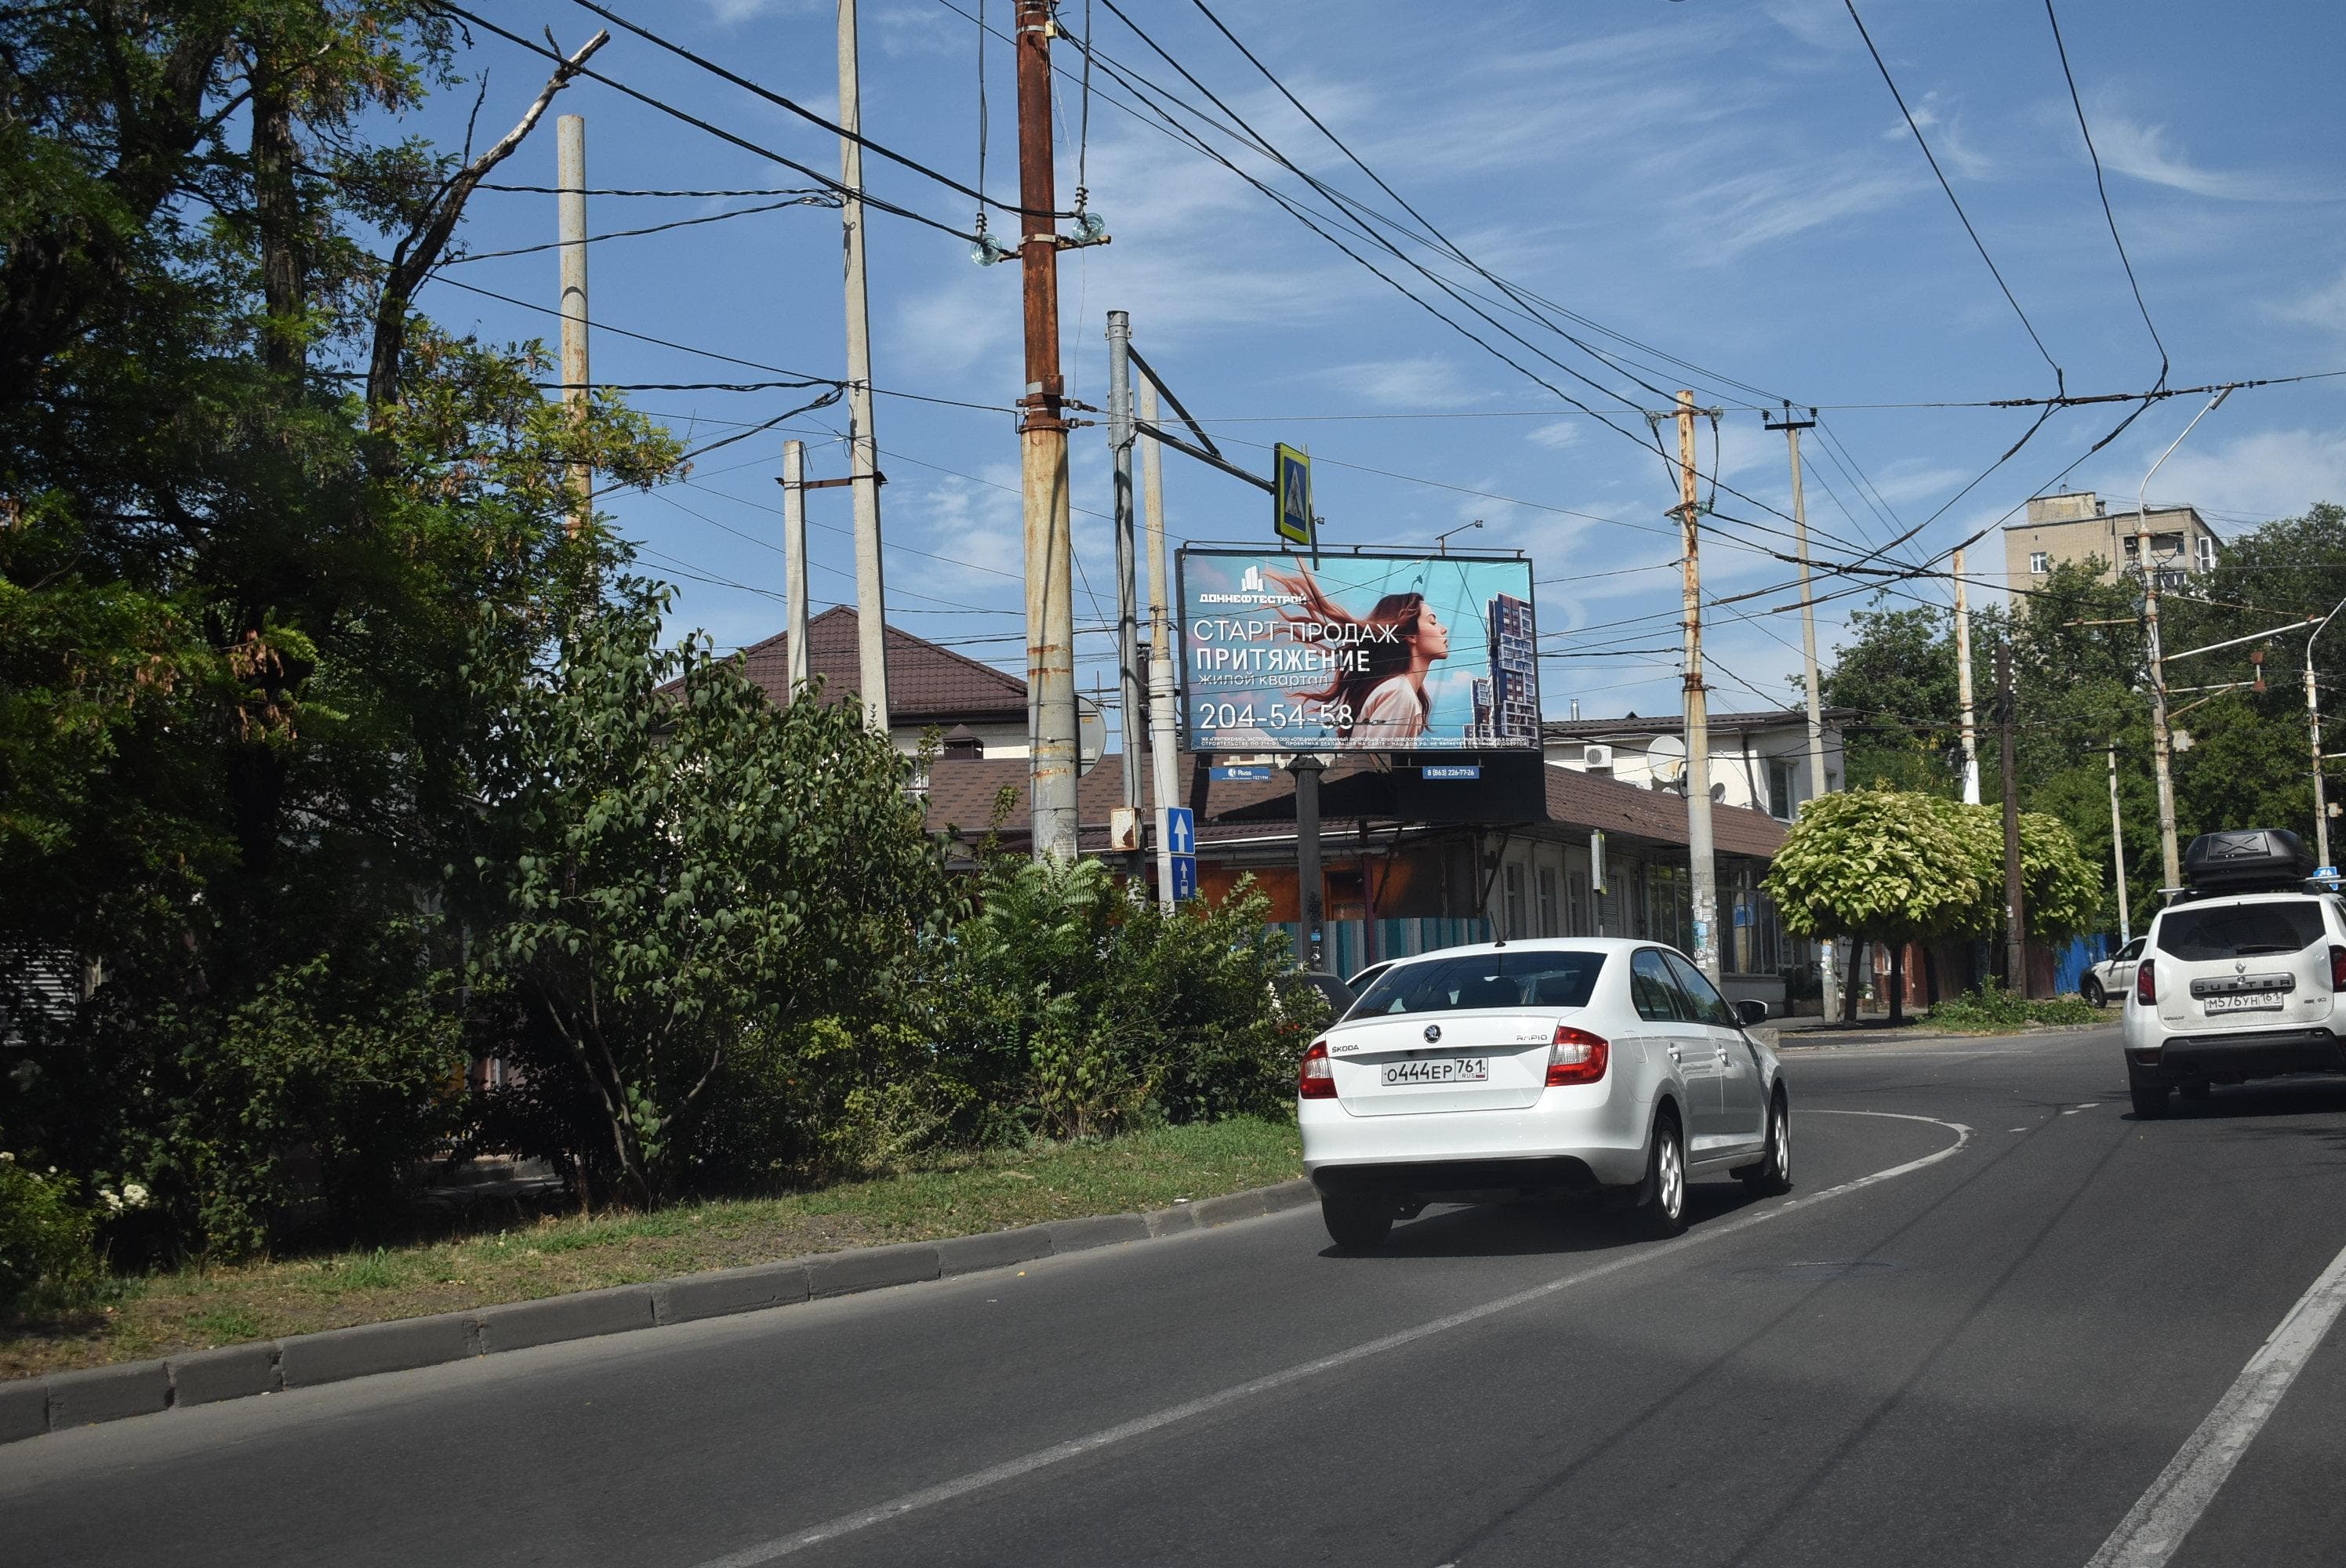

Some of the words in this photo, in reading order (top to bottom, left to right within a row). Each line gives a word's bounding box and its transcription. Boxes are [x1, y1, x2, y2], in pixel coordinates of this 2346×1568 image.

[1199, 593, 1307, 604] ДОННЕФТЕСТРОЙ
[1194, 620, 1279, 642] СТАРТ
[1290, 622, 1399, 647] ПРОДАЖ
[1197, 648, 1371, 672] ПРИТЯЖЕНИЕ
[1198, 671, 1255, 685] жилой
[1259, 674, 1329, 689] квартал
[1199, 702, 1353, 730] 204-54-58
[1433, 768, 1447, 777] (863)
[2195, 979, 2291, 992] DUSTER
[1387, 1062, 1452, 1083] О444ЕР
[1457, 1059, 1484, 1074] 761
